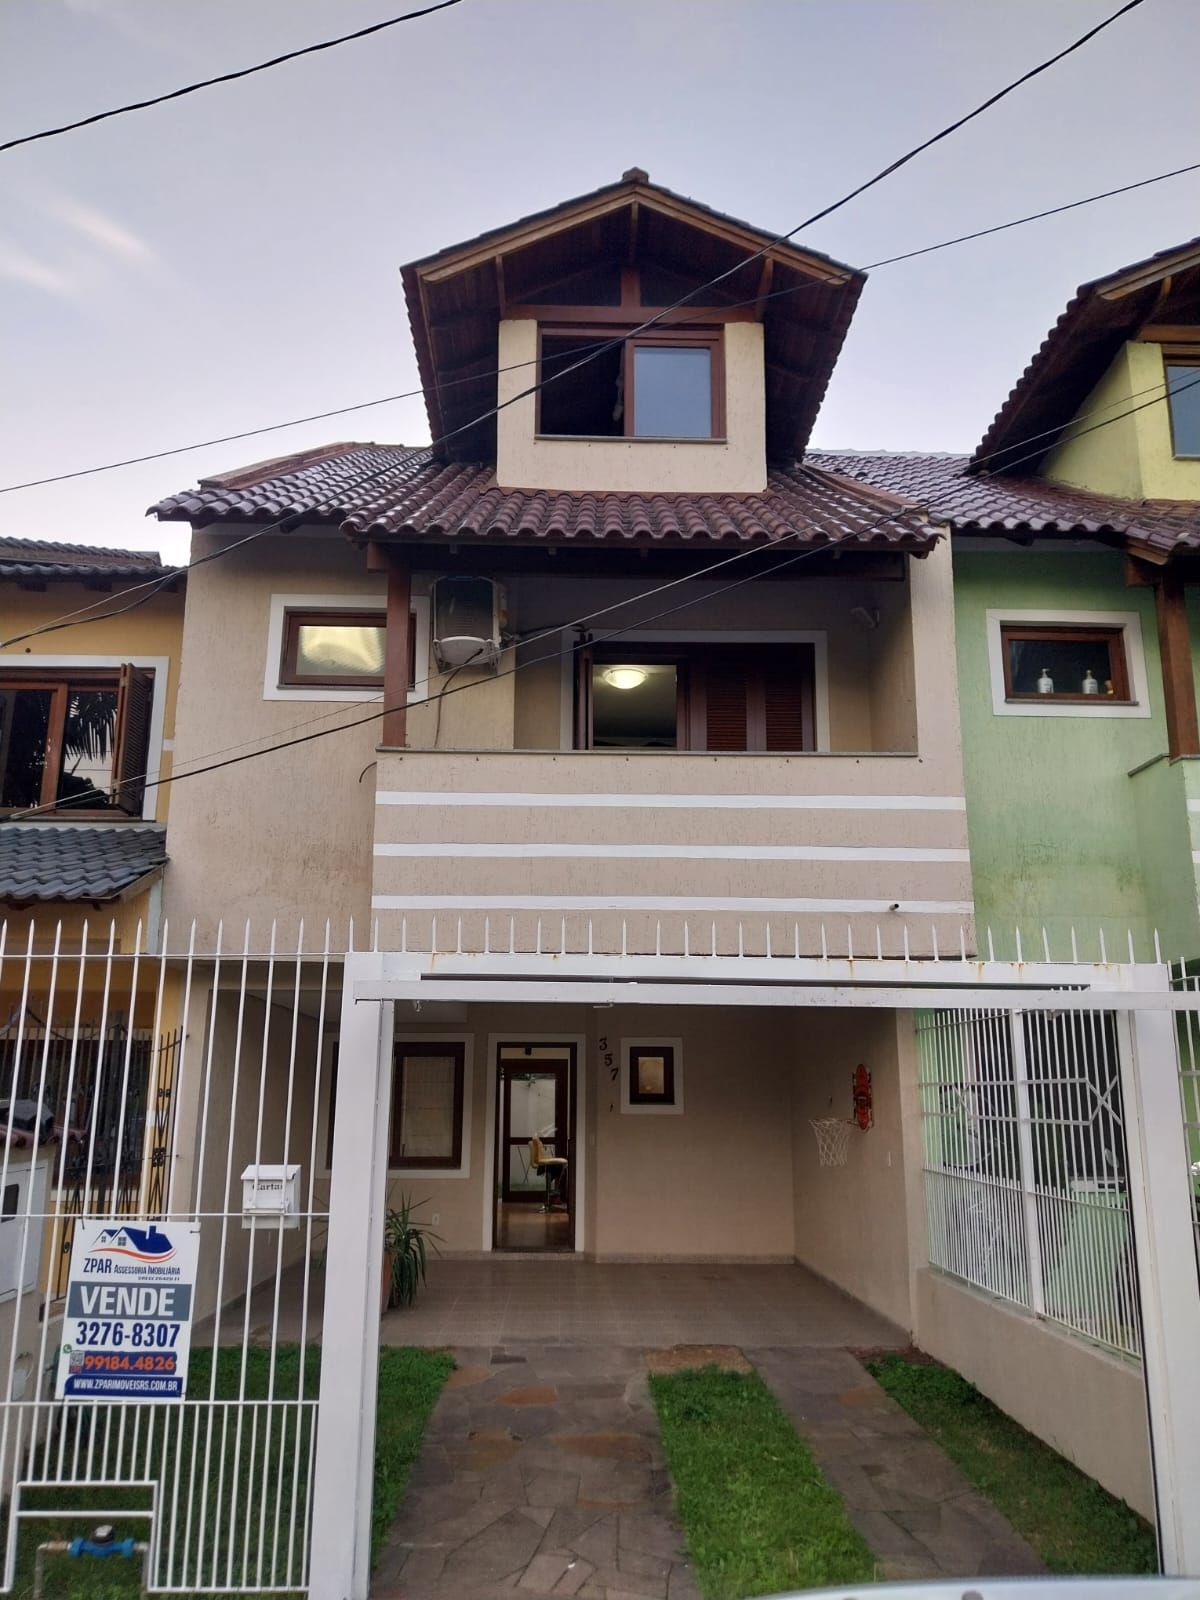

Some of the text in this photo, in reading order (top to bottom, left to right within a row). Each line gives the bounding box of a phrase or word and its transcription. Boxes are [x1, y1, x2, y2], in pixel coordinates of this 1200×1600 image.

[599, 1036, 619, 1081] 357
[252, 1183, 284, 1191] Carta
[83, 1257, 112, 1274] ZPAR
[80, 1285, 176, 1317] VENDE
[75, 1321, 181, 1348] 3276-8307
[84, 1355, 176, 1372] 99184.4826
[73, 1378, 178, 1392] WWW.ZPARIMOVEISRS.COM.BR
